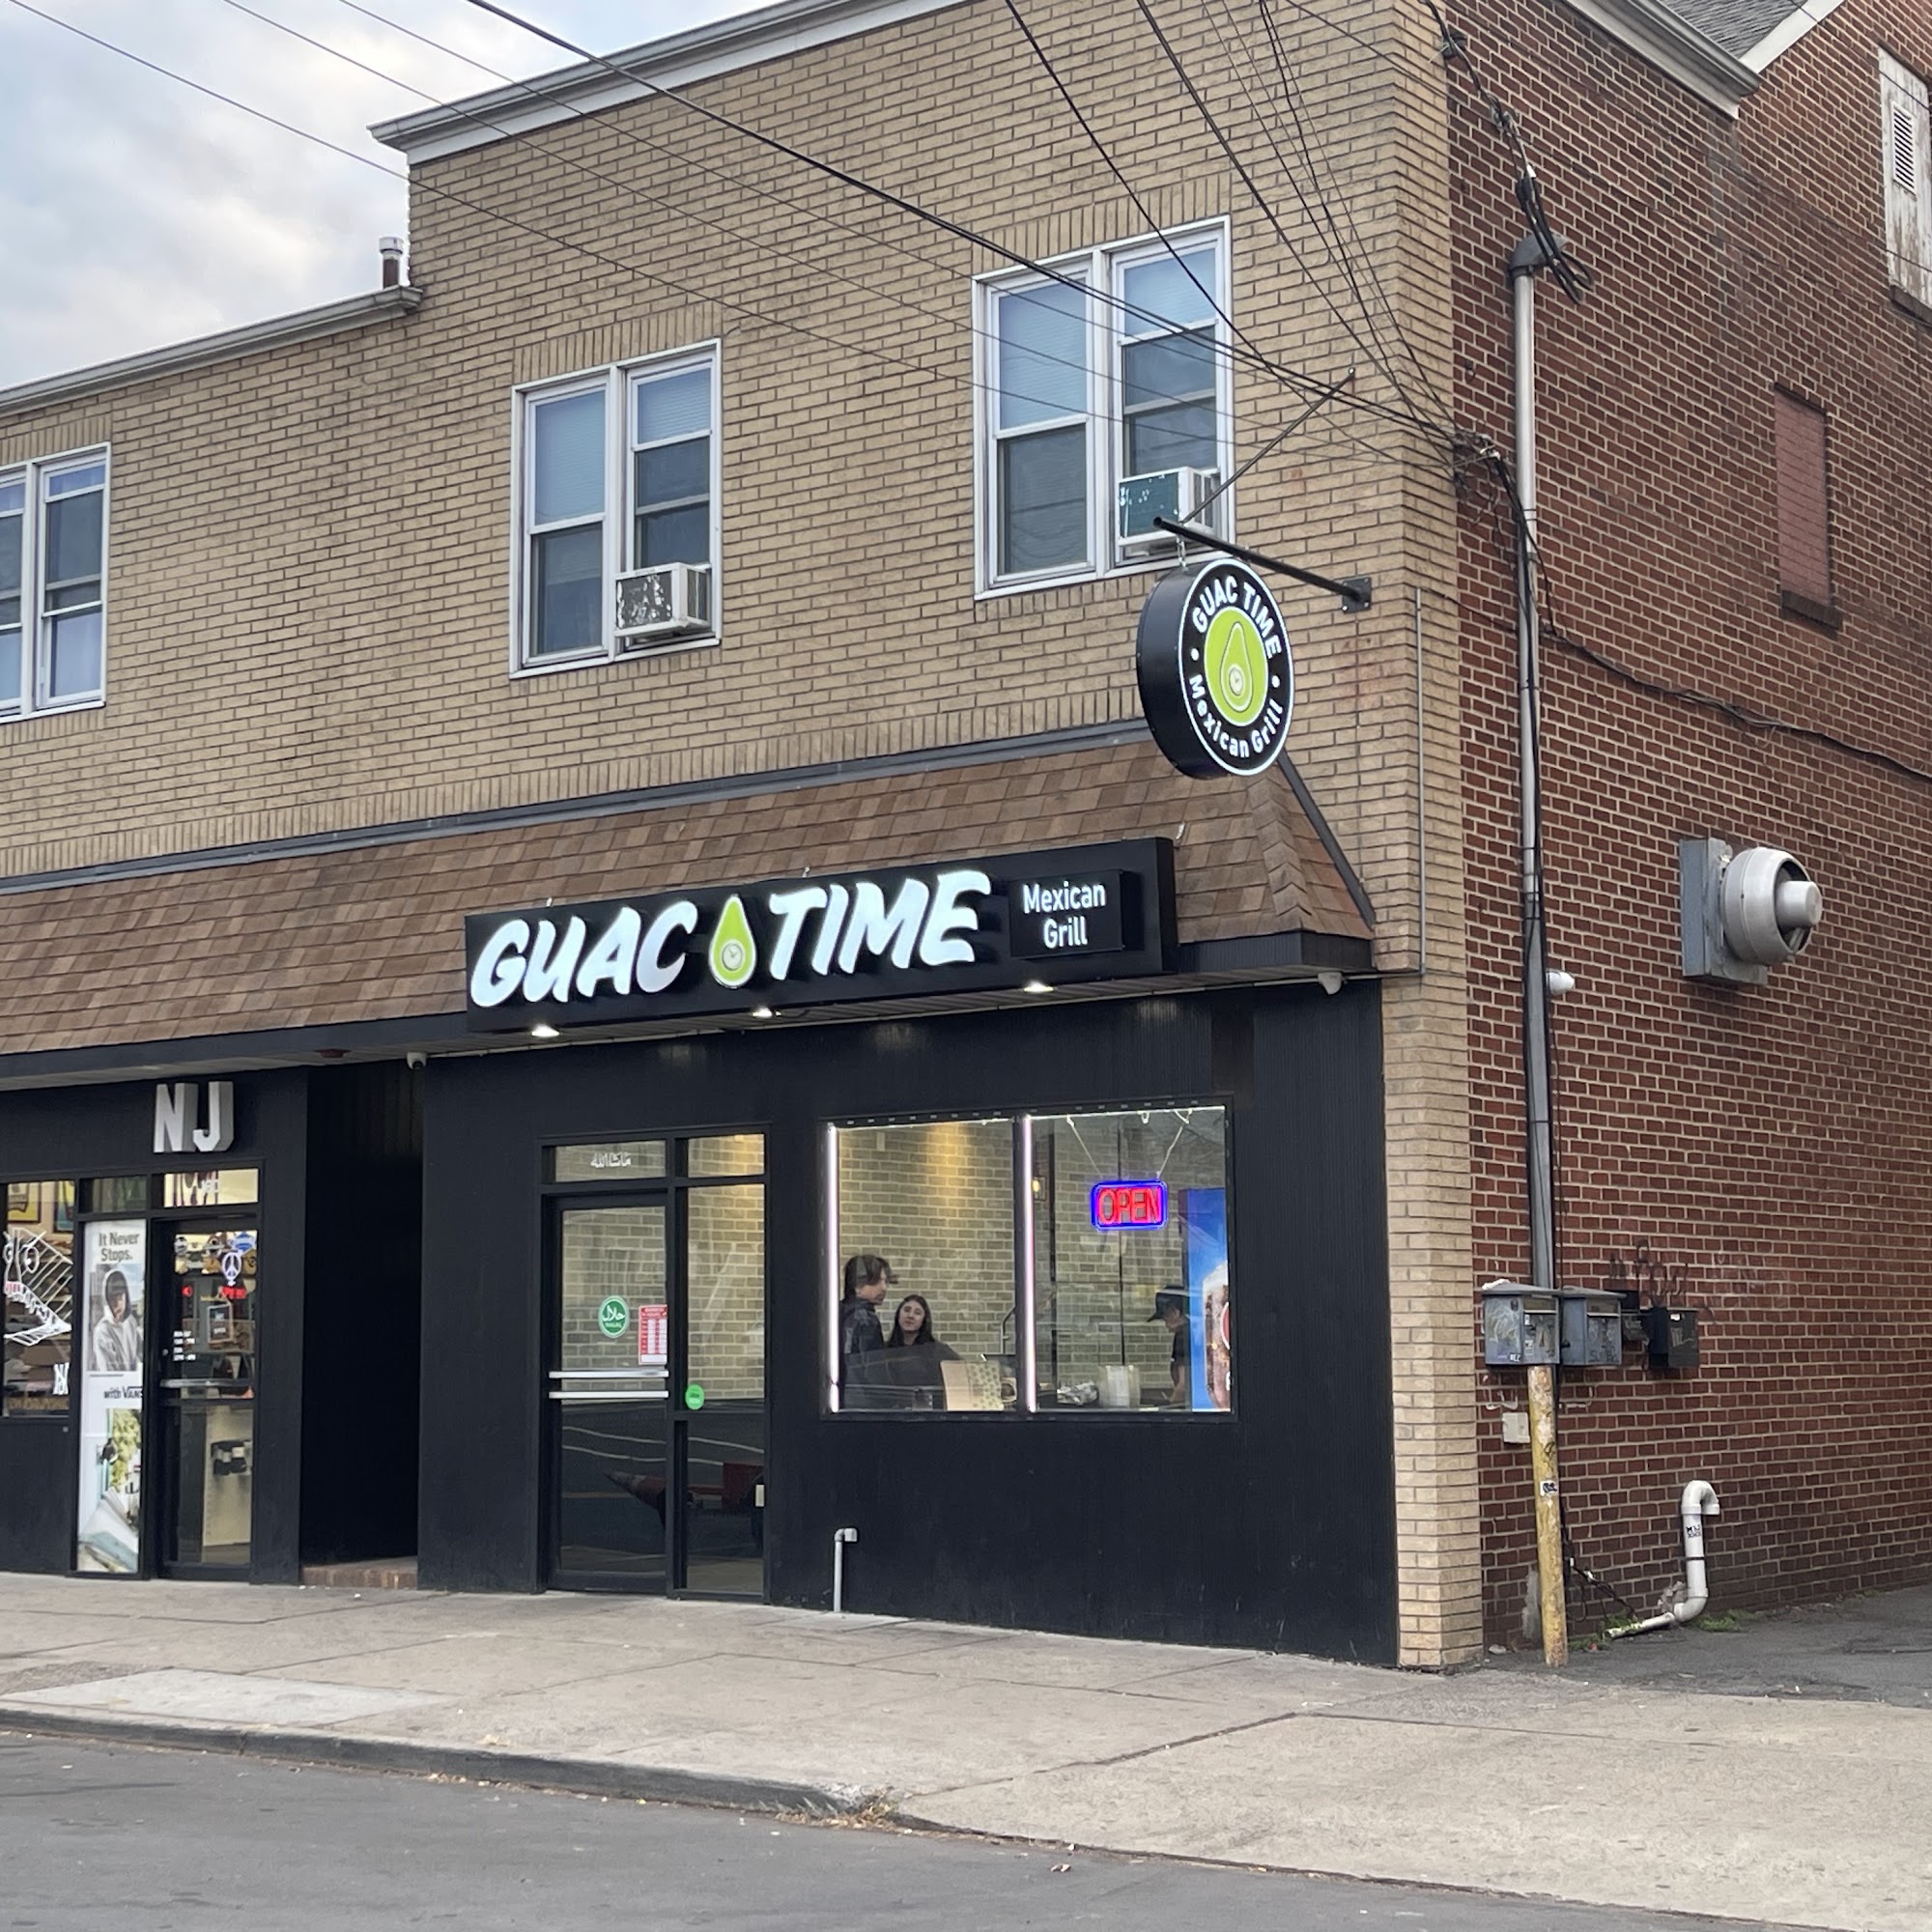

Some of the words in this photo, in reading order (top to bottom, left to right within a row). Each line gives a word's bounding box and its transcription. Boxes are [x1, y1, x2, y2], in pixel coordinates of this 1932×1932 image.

[1191, 575, 1238, 634] GUAC
[1242, 582, 1283, 660] TIME
[1189, 674, 1250, 758] Mexican
[1251, 698, 1284, 753] Grill
[1022, 880, 1107, 913] Mexican
[469, 899, 697, 1009] GUAC
[768, 869, 992, 981] TIME
[1042, 917, 1089, 950] Grill
[153, 1080, 234, 1153] NJ
[1097, 1187, 1162, 1225] OPEN
[99, 1232, 107, 1246] It
[109, 1232, 140, 1246] Never
[100, 1247, 133, 1263] Stops.
